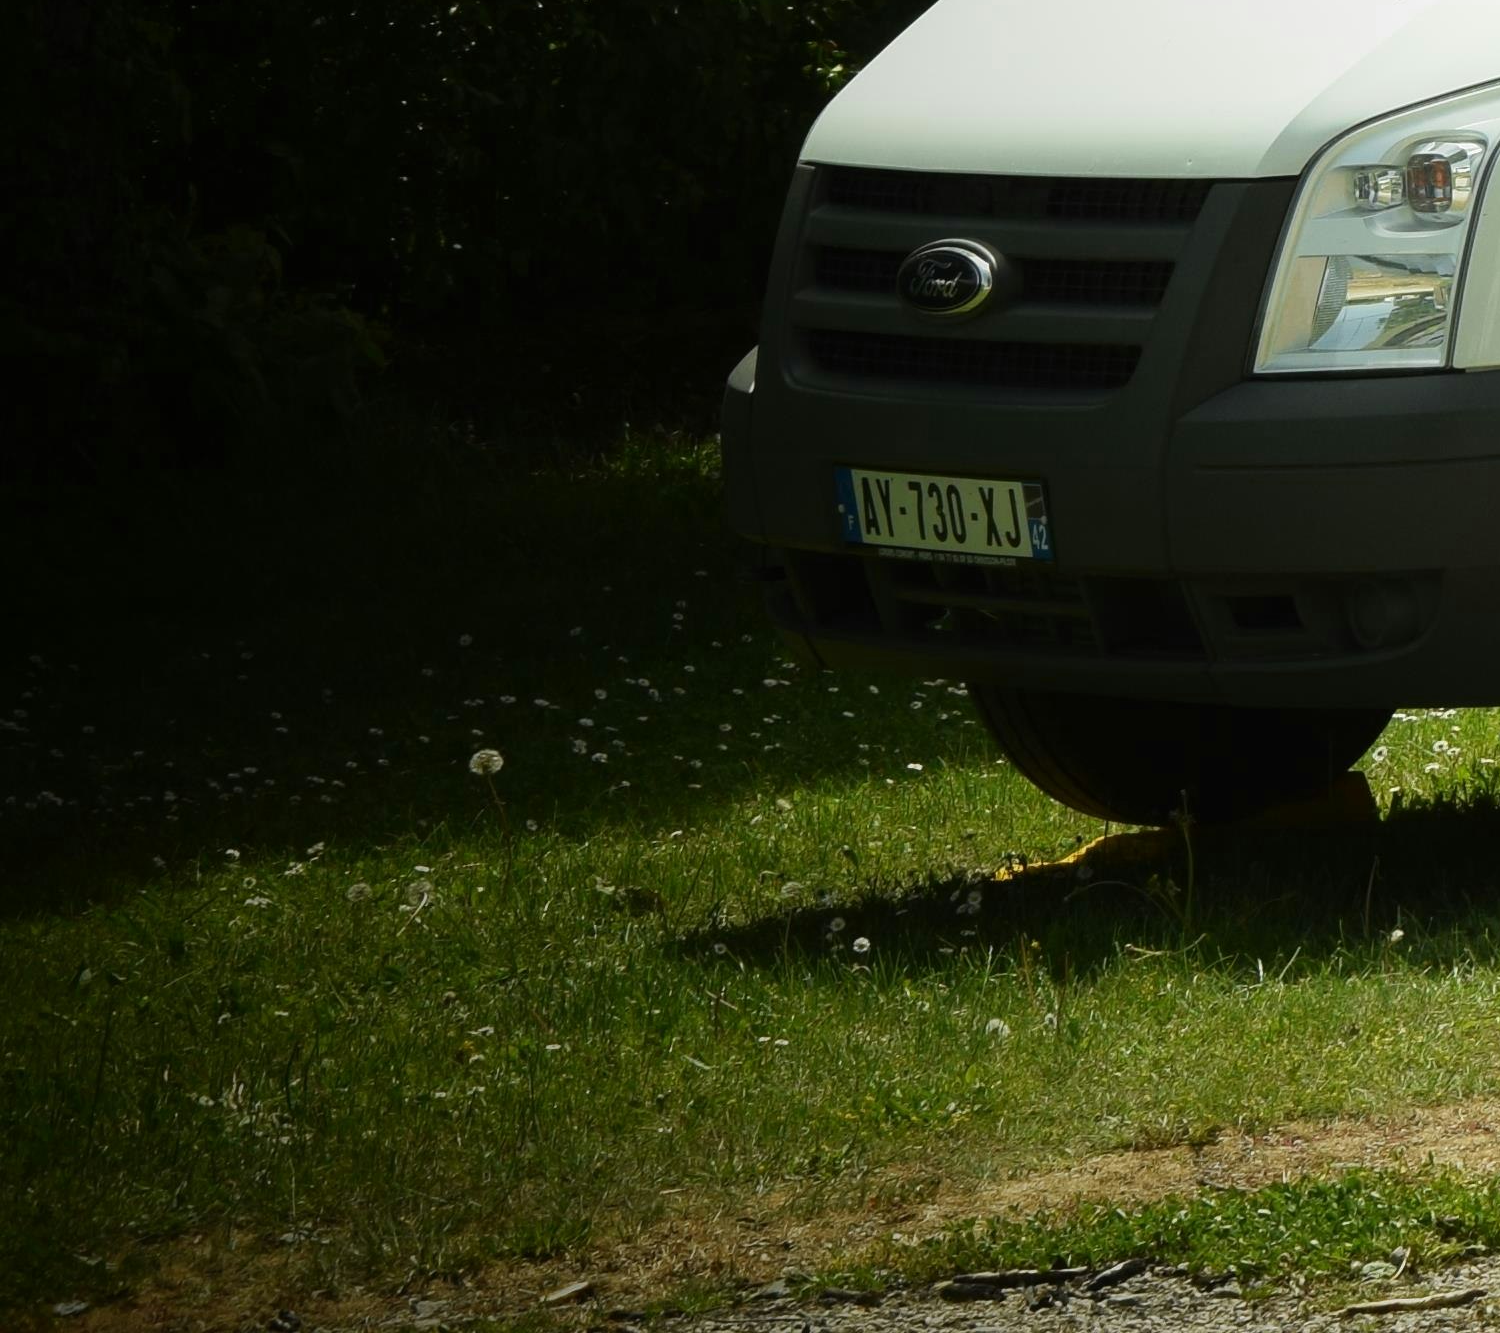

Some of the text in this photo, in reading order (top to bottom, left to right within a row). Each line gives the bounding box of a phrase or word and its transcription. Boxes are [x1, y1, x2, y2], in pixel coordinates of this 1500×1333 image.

[909, 258, 963, 299] Ford
[847, 514, 855, 531] F
[860, 476, 1022, 549] AY-730-XJ
[1031, 524, 1049, 550] 42
